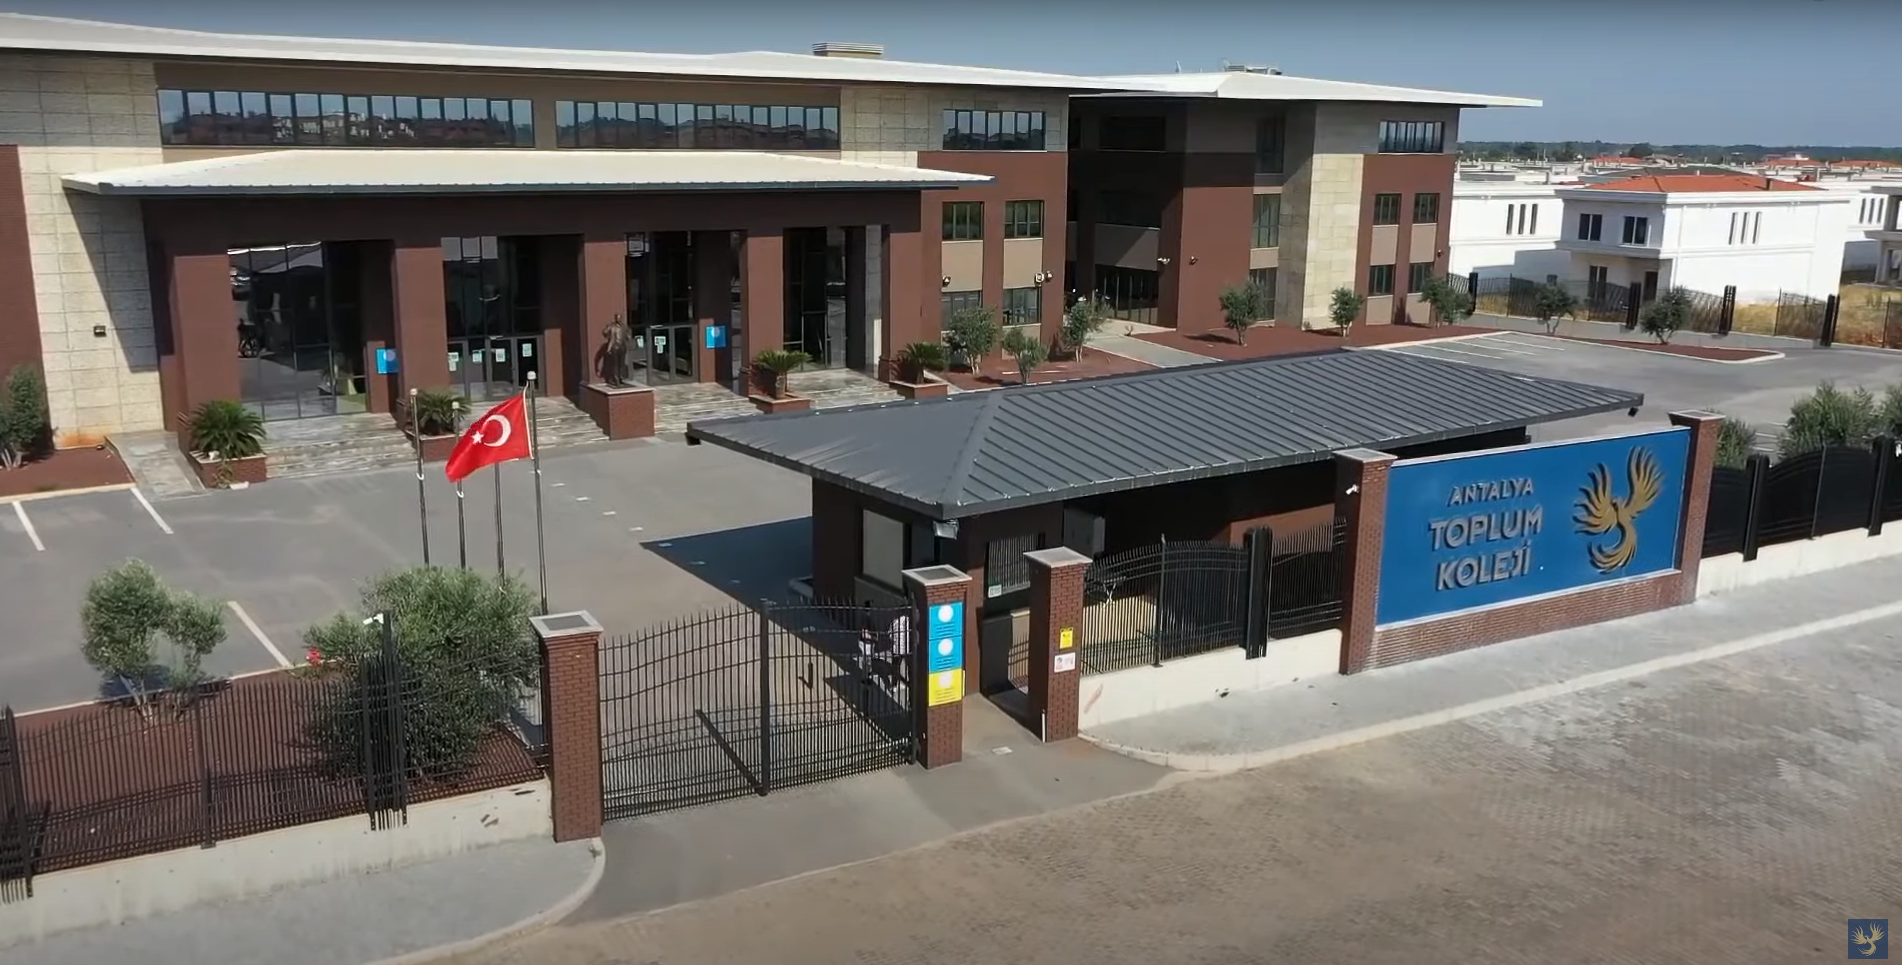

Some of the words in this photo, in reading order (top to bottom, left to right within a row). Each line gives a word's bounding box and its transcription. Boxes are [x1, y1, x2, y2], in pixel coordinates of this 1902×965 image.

[1449, 478, 1534, 506] ANTALYA
[1430, 505, 1543, 550] TOPLUM
[1437, 541, 1531, 591] KOLEJİ
